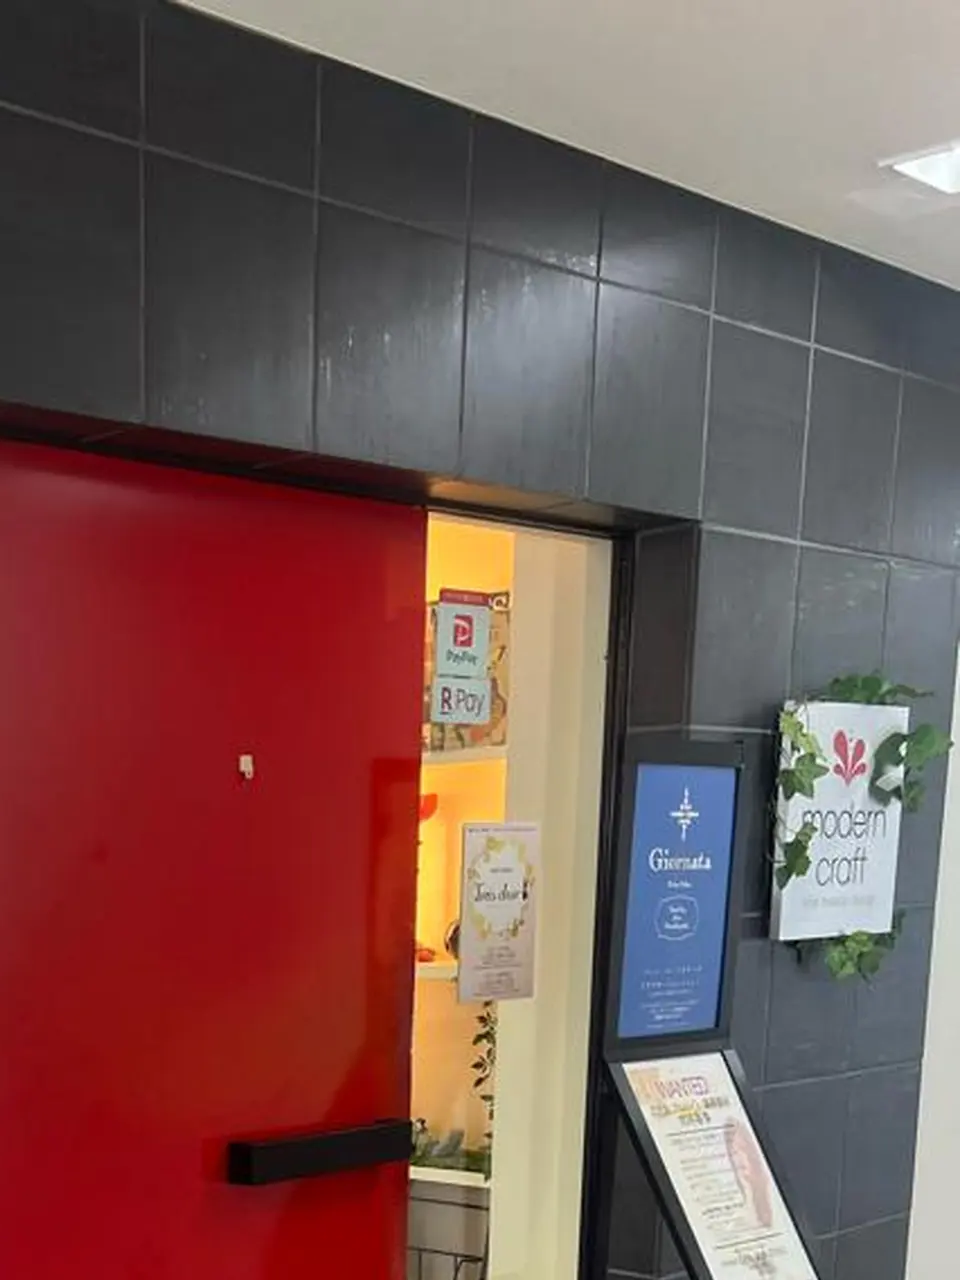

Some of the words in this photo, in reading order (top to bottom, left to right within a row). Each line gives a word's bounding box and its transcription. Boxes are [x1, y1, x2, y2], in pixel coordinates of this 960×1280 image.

[802, 801, 886, 839] modern
[648, 846, 713, 873] Giornata
[815, 846, 868, 887] craft
